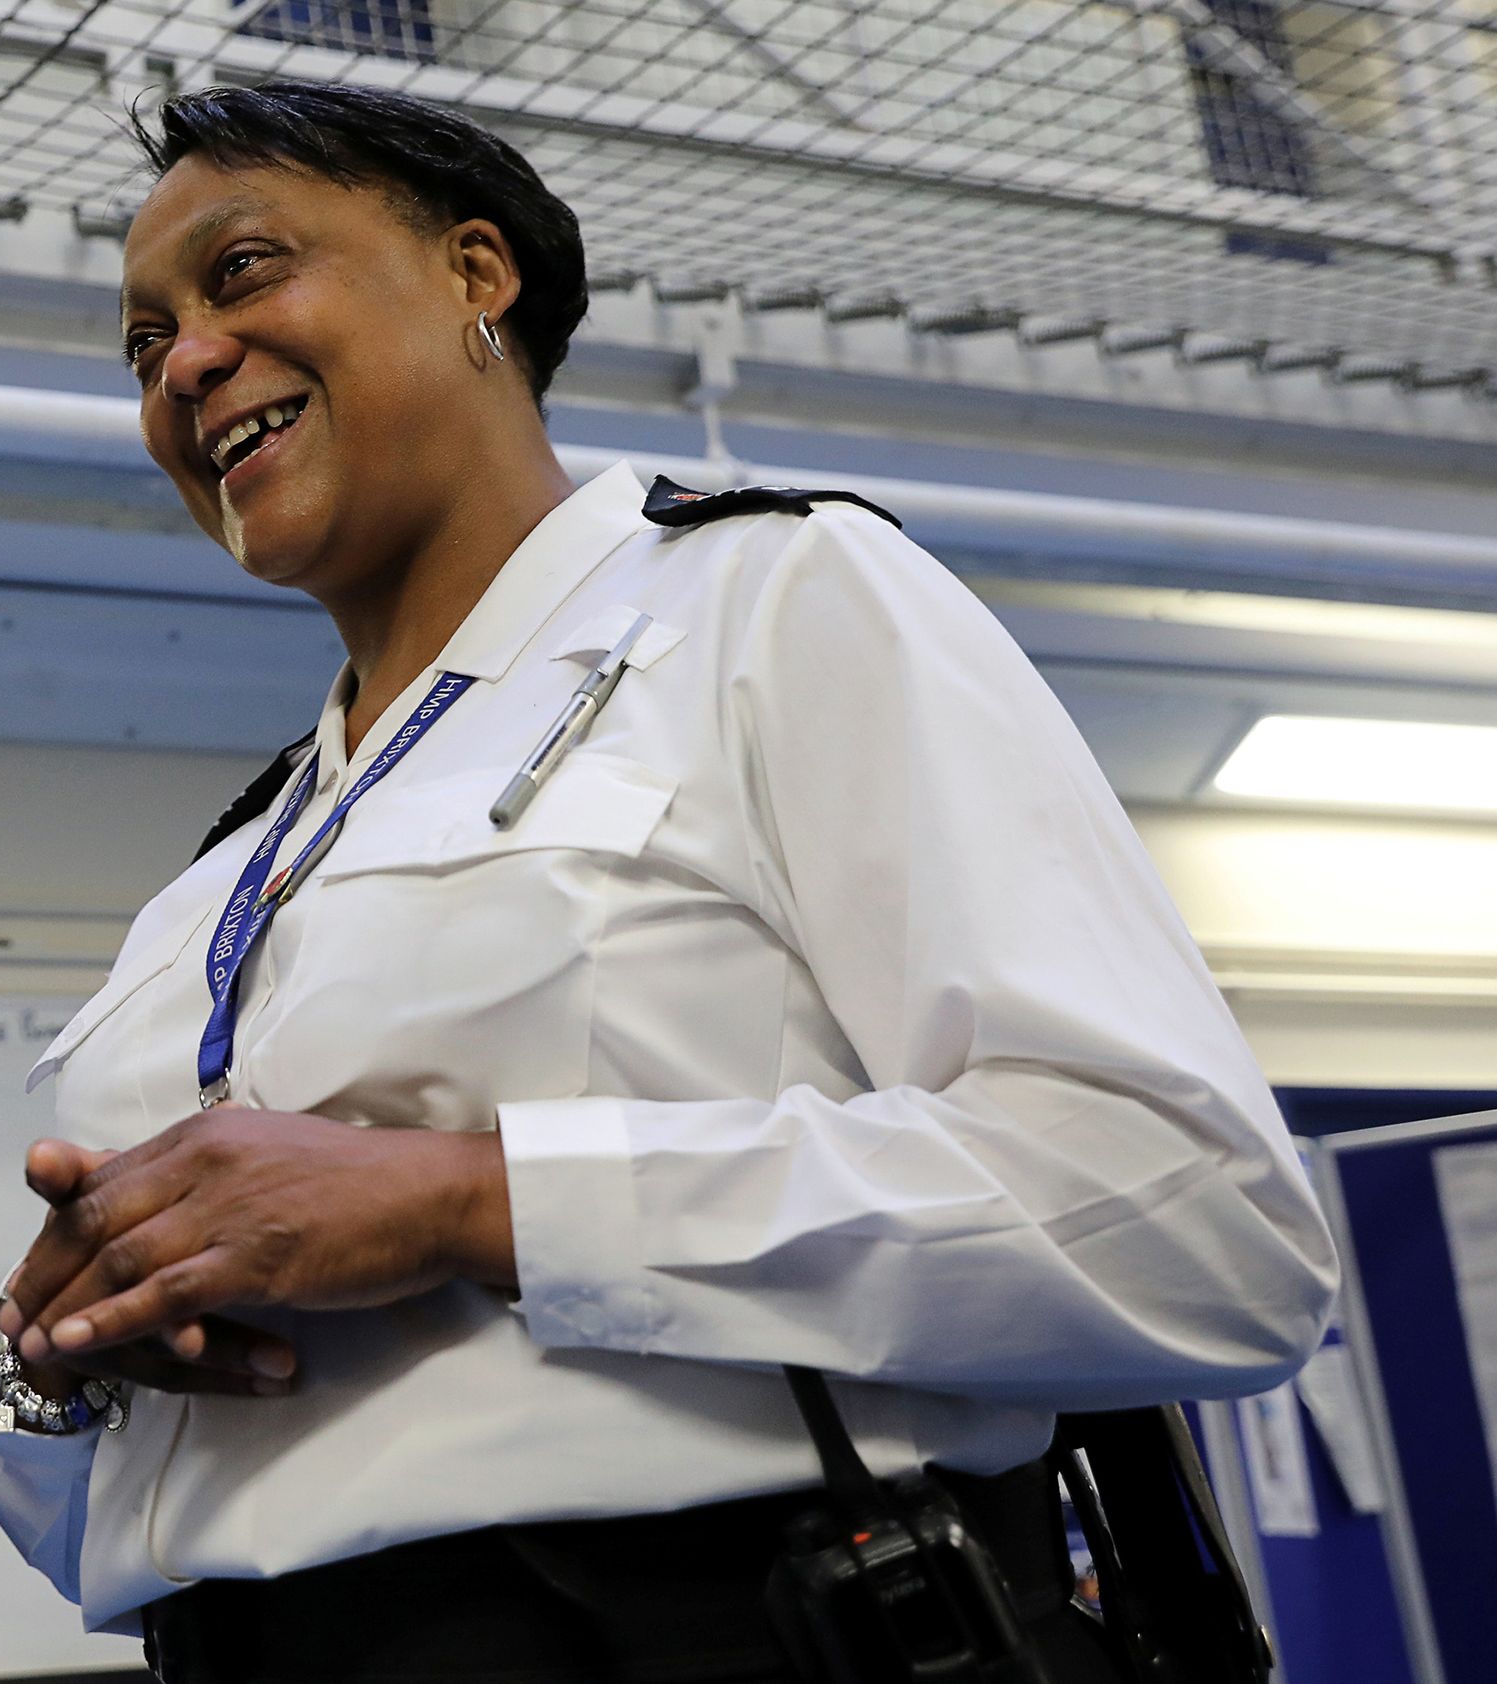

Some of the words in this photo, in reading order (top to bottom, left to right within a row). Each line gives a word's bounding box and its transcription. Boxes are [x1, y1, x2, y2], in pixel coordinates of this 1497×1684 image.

[419, 679, 462, 720] HMP
[342, 724, 421, 806] BRIXTON
[214, 885, 254, 962] BRIXTON
